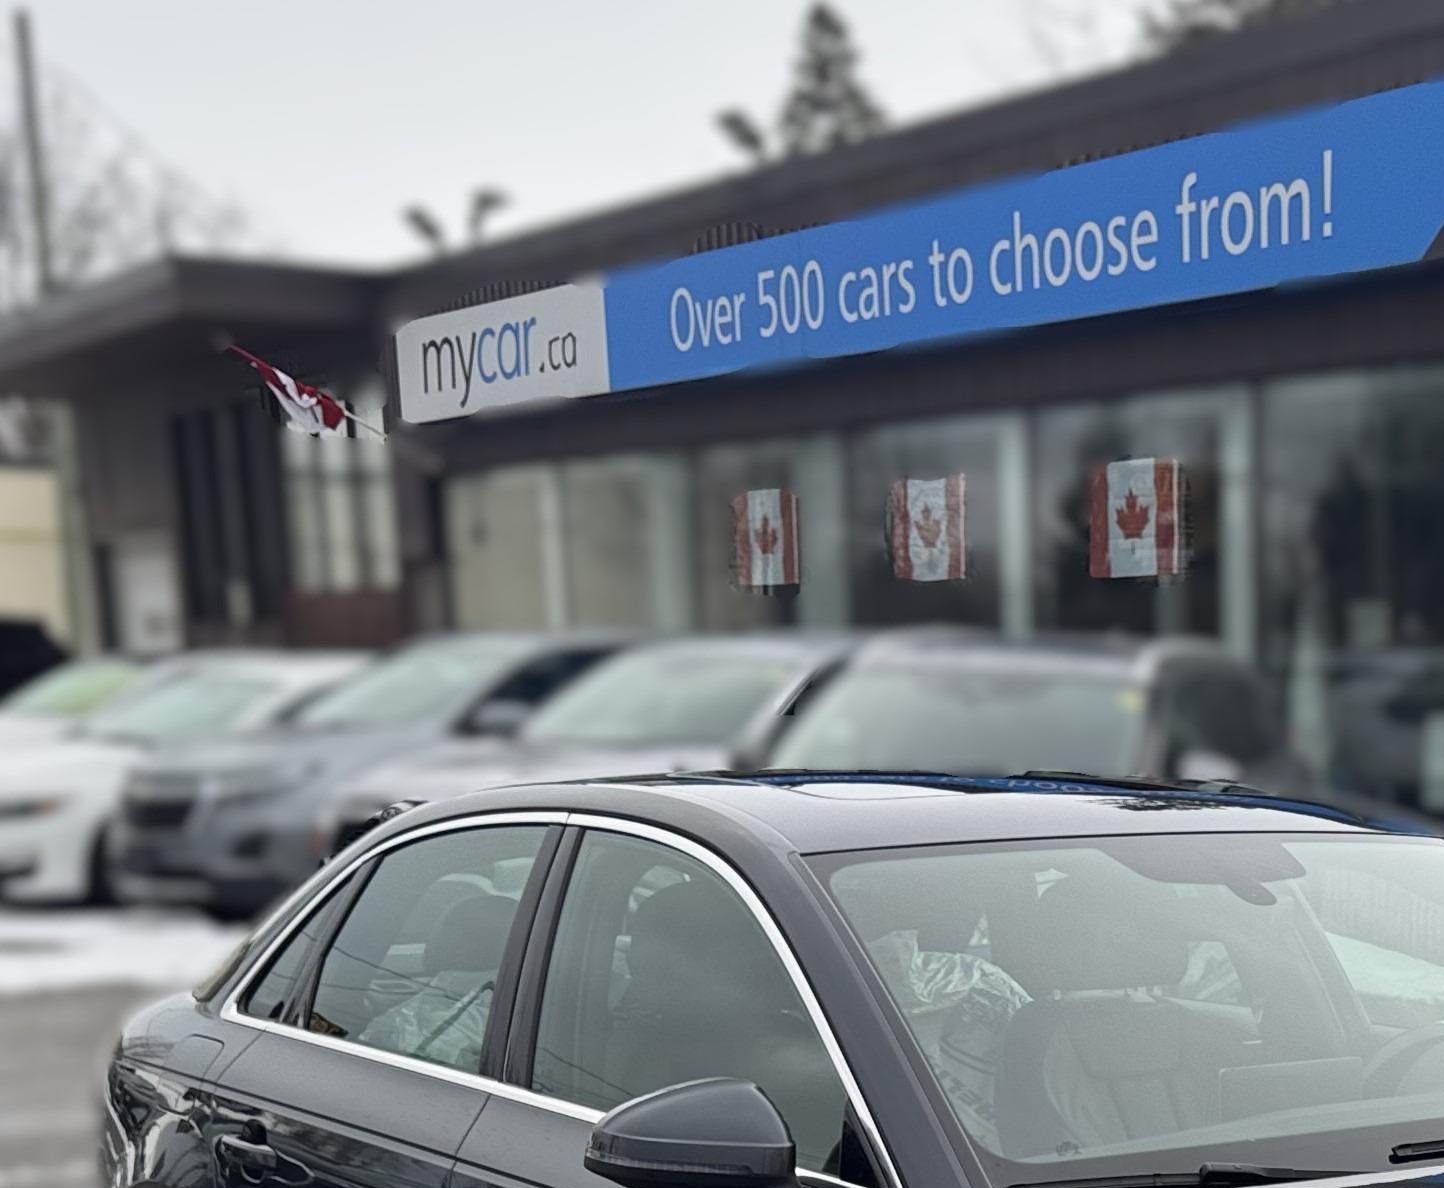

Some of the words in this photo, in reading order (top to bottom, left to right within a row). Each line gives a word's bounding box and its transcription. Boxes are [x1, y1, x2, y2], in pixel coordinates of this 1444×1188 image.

[670, 287, 746, 352] Over
[757, 259, 825, 338] 500
[838, 259, 916, 324] cars
[928, 238, 974, 308] to
[988, 210, 1159, 297] choose
[1175, 149, 1333, 264] from!
[422, 316, 577, 409] mycar.ca
